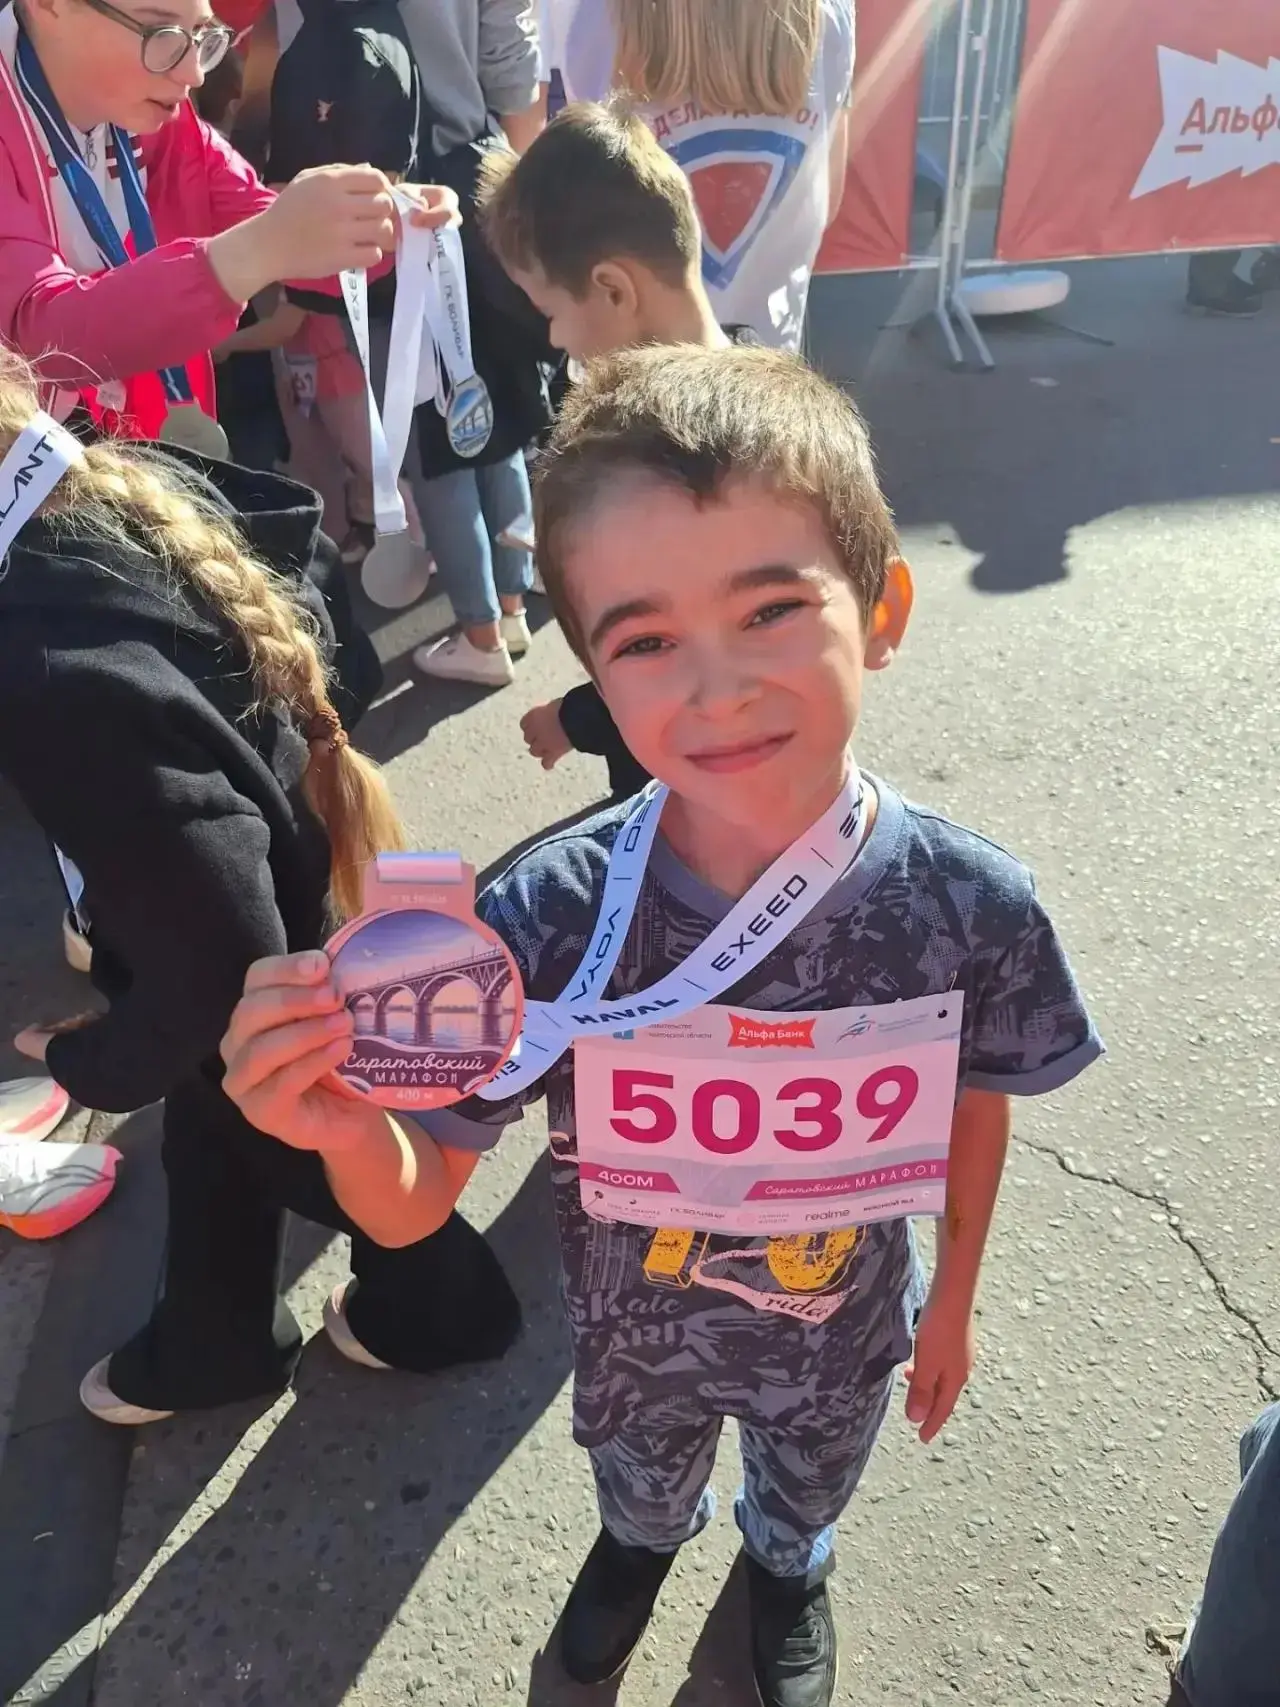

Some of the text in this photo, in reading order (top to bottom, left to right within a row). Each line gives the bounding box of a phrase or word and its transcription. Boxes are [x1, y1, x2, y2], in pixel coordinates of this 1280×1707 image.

[0, 431, 58, 525] LANT
[570, 873, 808, 1025] HAVAL EXEED
[570, 907, 622, 1002] VOYA
[738, 1026, 806, 1041] Альфа Банк
[343, 1052, 487, 1076] Саратовский
[374, 1071, 458, 1085] МАРАФОН
[609, 1064, 919, 1155] 5039
[804, 1207, 851, 1223] realme
